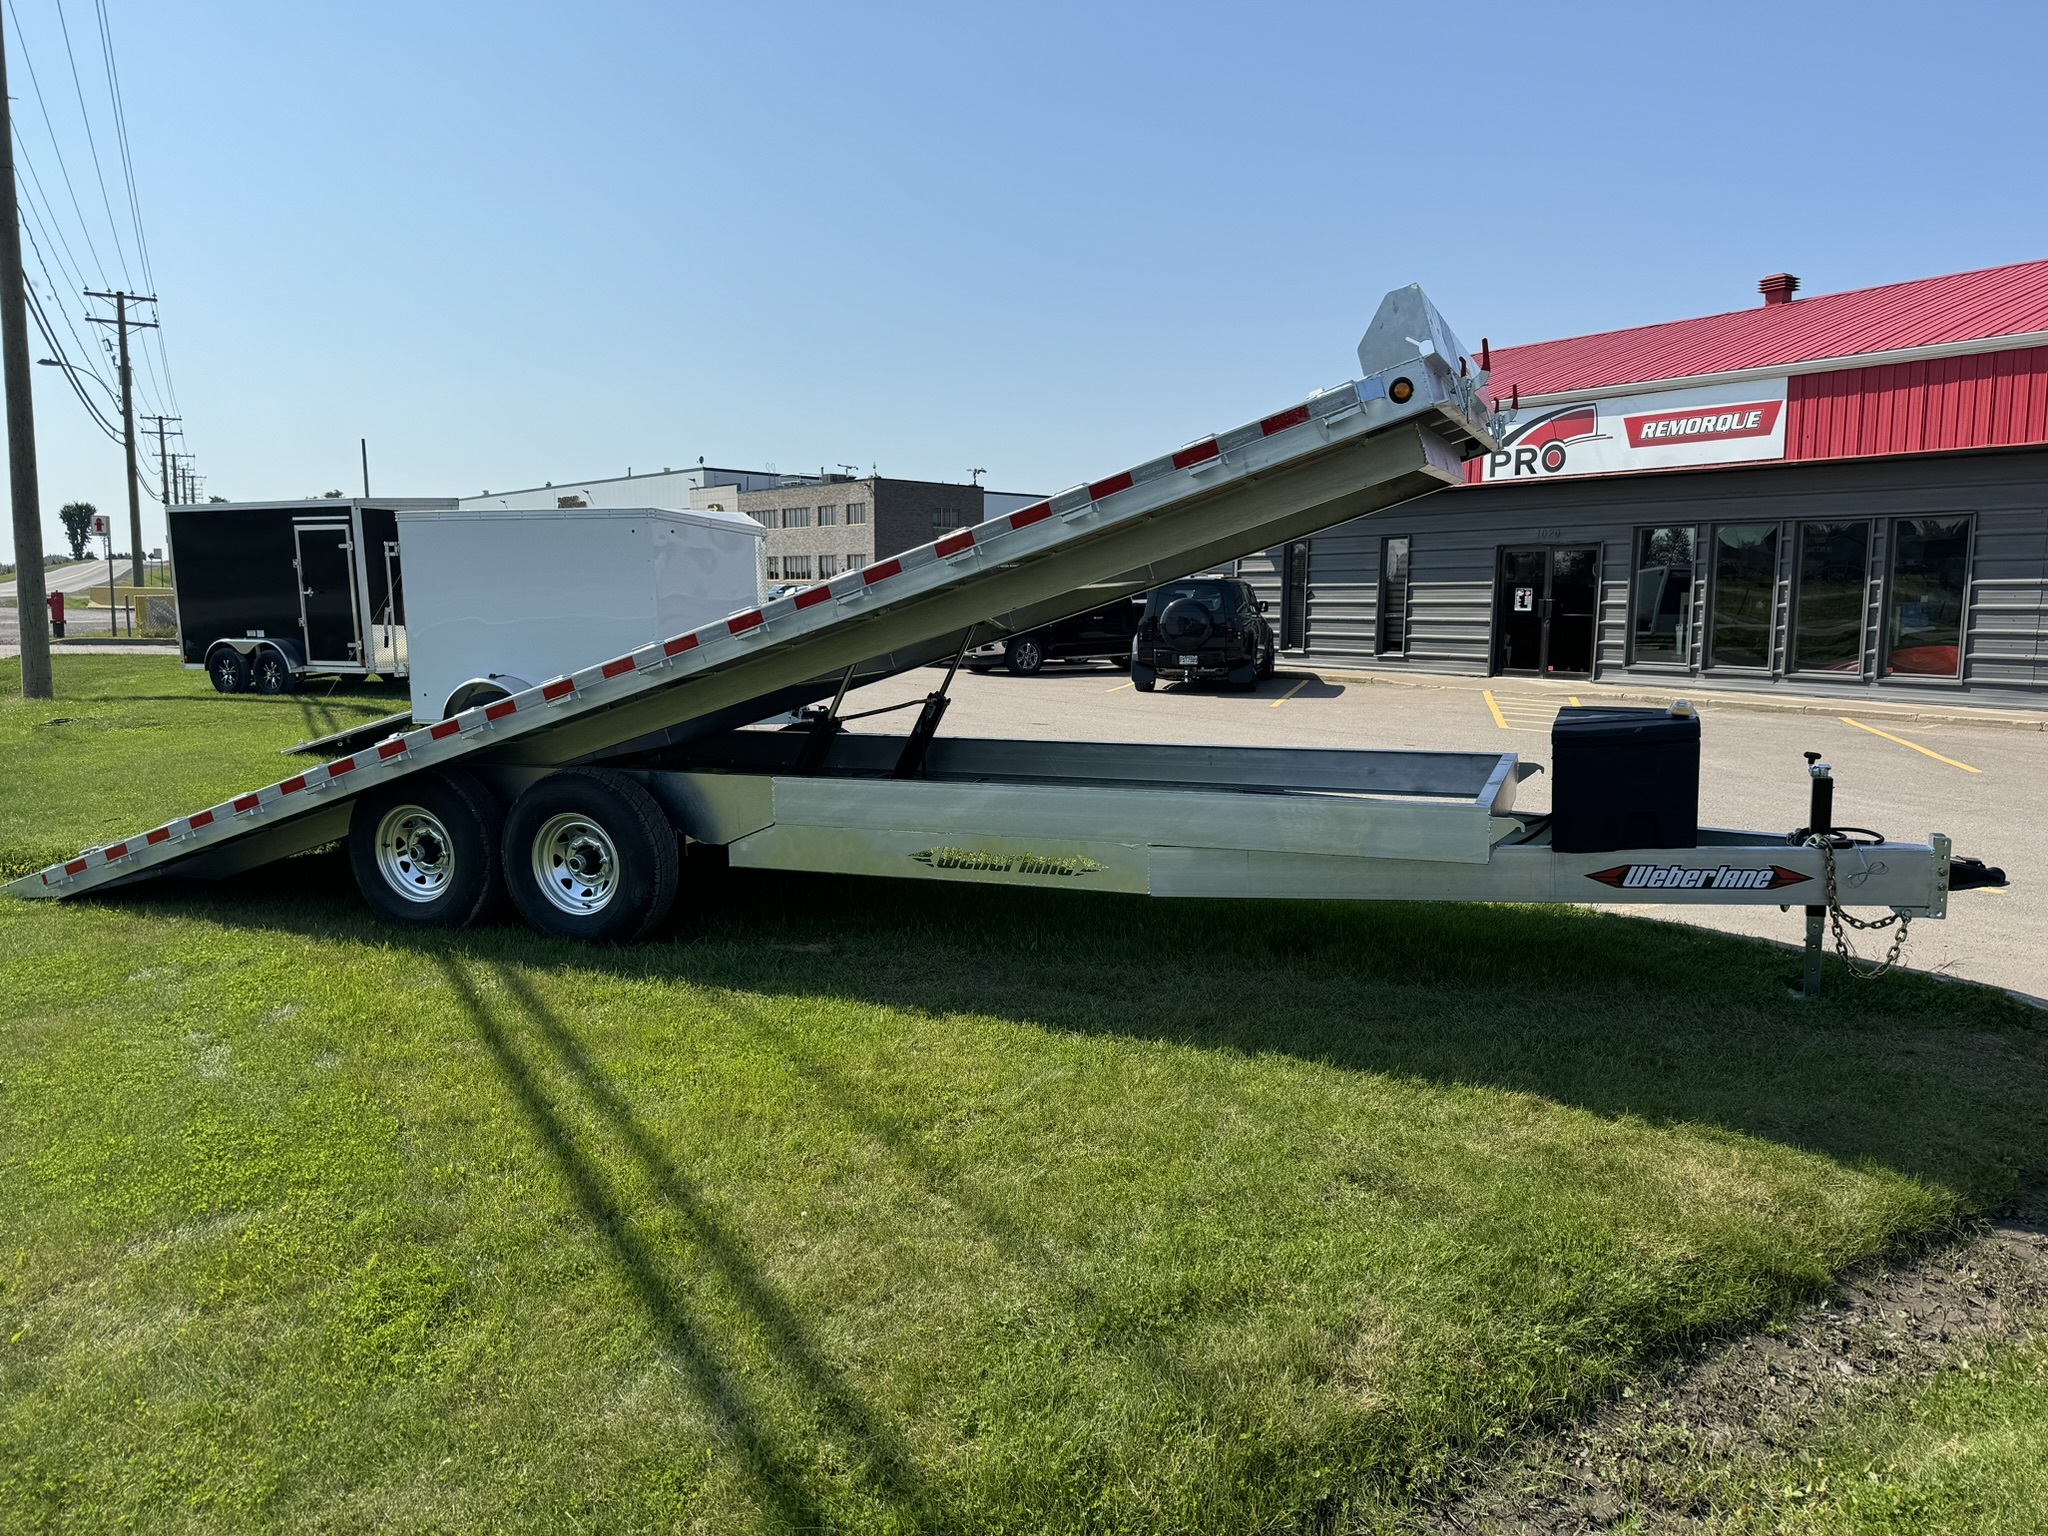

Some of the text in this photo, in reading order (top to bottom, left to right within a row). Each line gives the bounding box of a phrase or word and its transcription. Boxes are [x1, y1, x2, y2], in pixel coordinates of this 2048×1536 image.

[1639, 410, 1762, 440] REMORQUE
[1489, 444, 1566, 478] PRO
[1622, 865, 1774, 888] Weberlane
